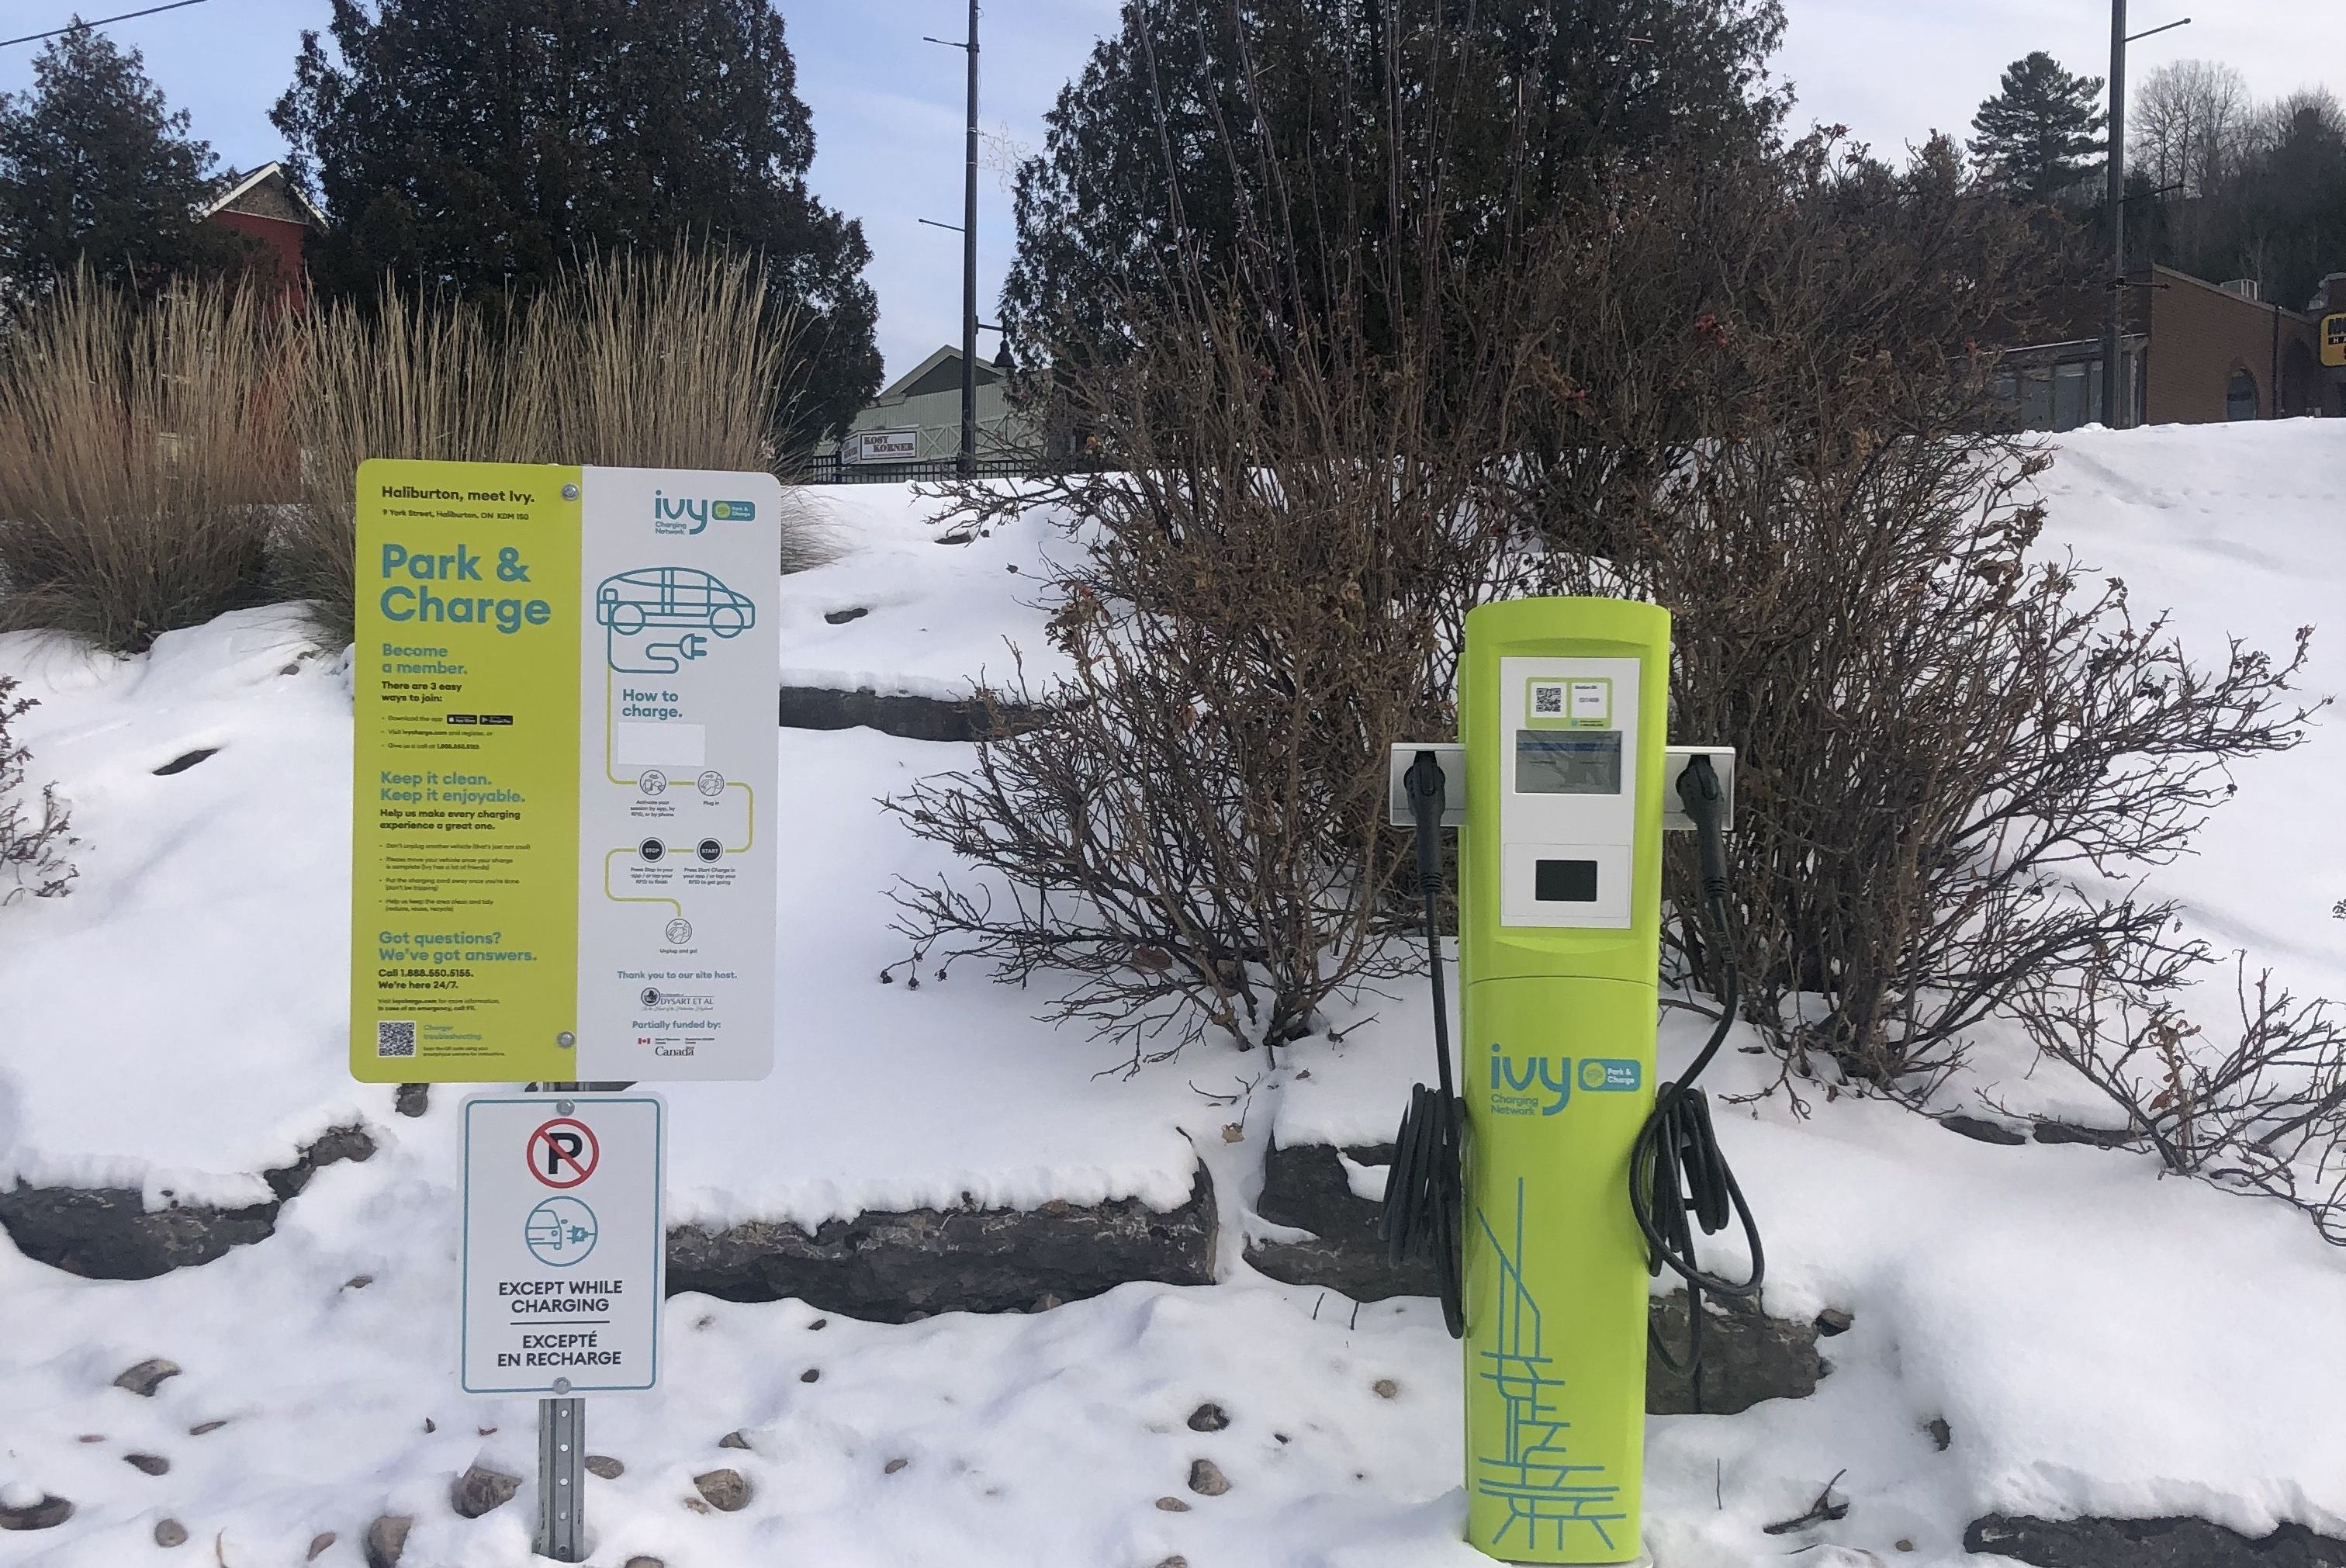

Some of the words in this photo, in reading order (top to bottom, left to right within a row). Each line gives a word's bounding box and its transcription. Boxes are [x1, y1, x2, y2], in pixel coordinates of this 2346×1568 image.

[864, 436, 889, 445] KOSY
[874, 443, 914, 452] KORNER
[382, 486, 464, 502] Haliburton,
[468, 491, 505, 501] meet
[510, 490, 535, 505] Ivy.
[656, 490, 708, 535] ivy
[656, 521, 687, 530] Charging
[382, 544, 483, 580] Park
[497, 547, 531, 582] &
[381, 586, 551, 633] Charge
[383, 643, 448, 657] Become
[382, 663, 392, 673] a
[397, 661, 467, 674] member.
[382, 681, 409, 690] There
[382, 694, 407, 703] ways
[422, 694, 442, 703] join:
[623, 689, 658, 701] How
[662, 691, 678, 702] to
[622, 704, 682, 720] charge.
[381, 771, 422, 787] Keep
[427, 772, 438, 784] it
[443, 772, 492, 785] clean.
[381, 788, 422, 804] Keep
[427, 788, 438, 801] it
[443, 789, 525, 805] enjoyable.
[380, 809, 403, 819] Help
[478, 810, 521, 820] charging
[380, 822, 434, 830] experience
[445, 822, 472, 831] great
[379, 931, 410, 944] Got
[415, 932, 500, 947] questions?
[379, 948, 428, 961] We've
[433, 950, 460, 964] got
[465, 950, 537, 961] answers.
[400, 969, 473, 978] 1.888.550.5155.
[618, 971, 645, 979] Thank
[715, 971, 737, 979] host.
[379, 981, 406, 989] We're
[409, 981, 431, 989] here
[433, 981, 458, 989] 24/7.
[632, 1021, 670, 1030] Partially
[707, 1021, 721, 1030] by:
[656, 1047, 694, 1056] Canada
[1492, 1043, 1570, 1116] ivy
[1492, 1094, 1538, 1106] Charging
[1492, 1105, 1535, 1116] Network
[548, 1132, 583, 1174] P
[499, 1282, 564, 1296] EXCEPT
[569, 1281, 622, 1294] WHILE
[511, 1298, 609, 1313] CHARGING
[523, 1331, 597, 1348] EXCEPTÉ
[498, 1353, 521, 1367] EN
[526, 1352, 621, 1367] RECHARGE
